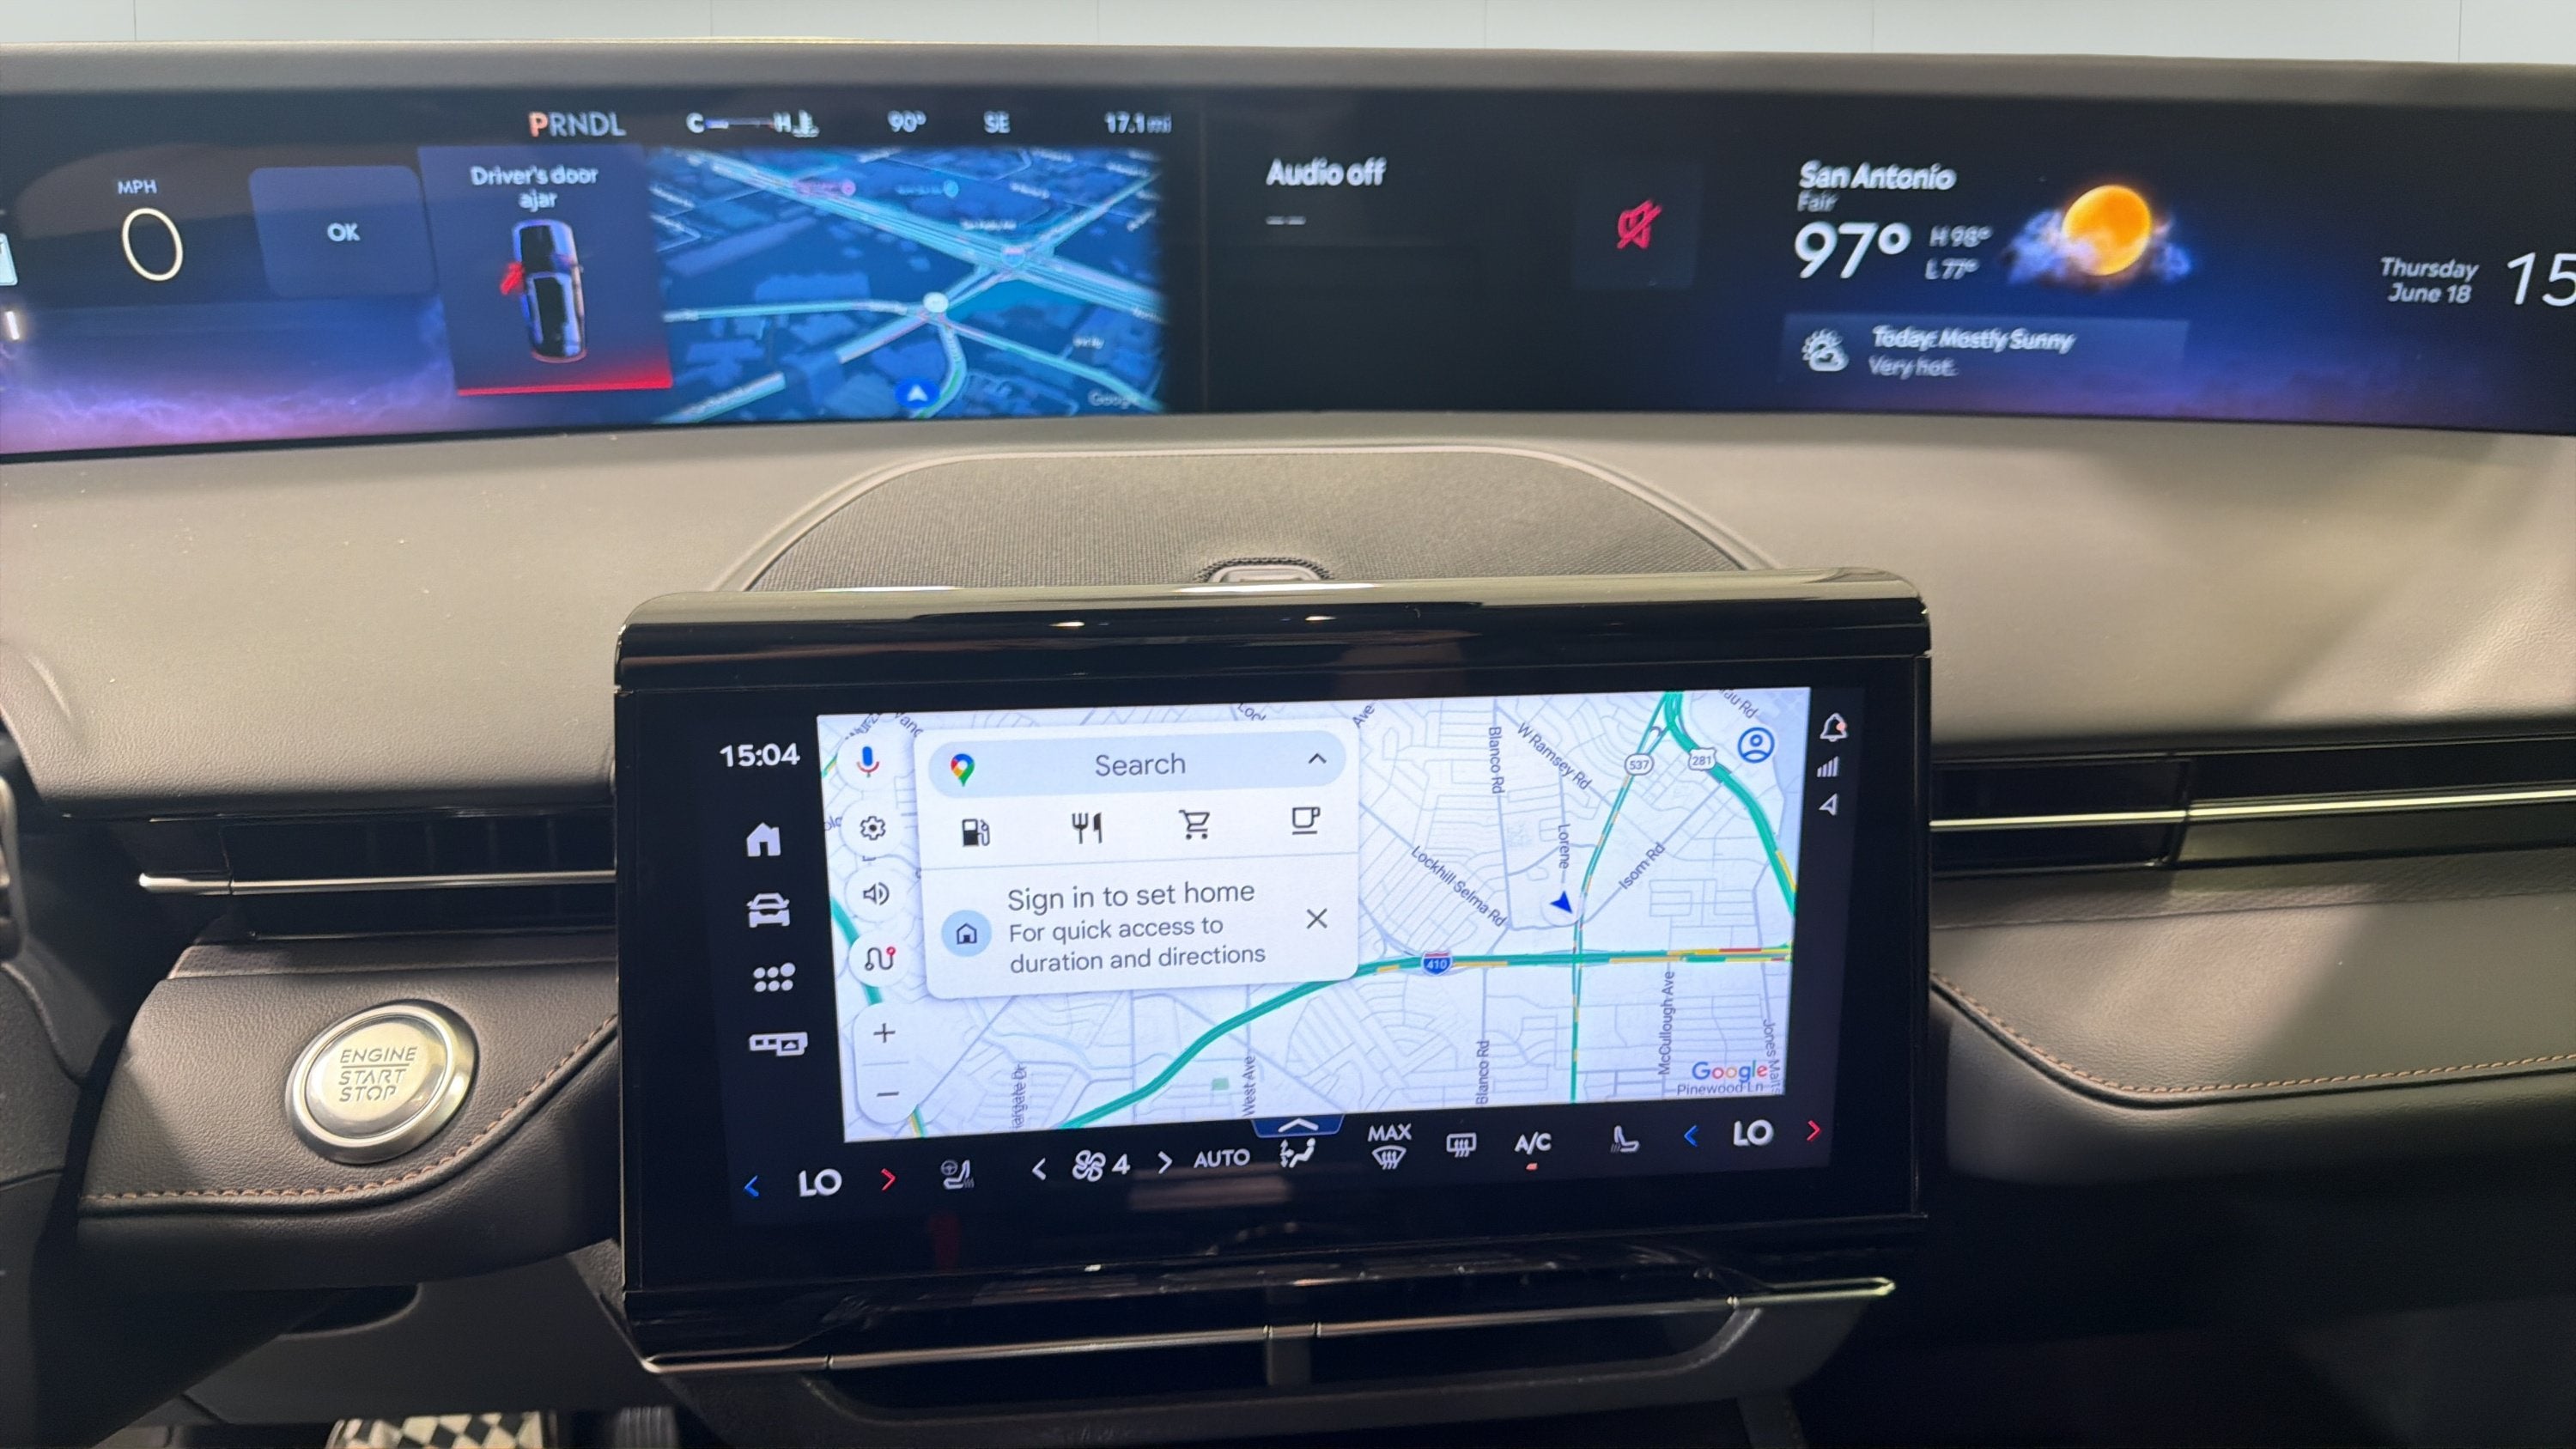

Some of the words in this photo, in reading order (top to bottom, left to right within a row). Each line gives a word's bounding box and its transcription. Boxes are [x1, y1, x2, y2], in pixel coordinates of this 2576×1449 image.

[530, 113, 626, 137] PRNDL
[687, 113, 704, 133] C
[774, 112, 791, 132] H
[888, 110, 926, 132] 90°
[984, 111, 1010, 133] SE
[1105, 112, 1145, 133] 17.1
[471, 166, 549, 186] Driver's
[553, 167, 598, 185] door
[1266, 157, 1345, 186] Audio
[1346, 157, 1387, 186] off
[1800, 160, 1849, 189] San
[1850, 161, 1957, 191] Antonio
[118, 180, 157, 195] MPH
[519, 191, 556, 212] ajar
[1797, 192, 1838, 212] Fair
[327, 223, 360, 242] OK
[1929, 228, 1948, 246] H
[1795, 222, 1911, 278] 97°
[1925, 259, 1938, 279] L
[2381, 257, 2479, 282] Thursday
[2506, 252, 2576, 307] 15
[2388, 283, 2442, 302] June
[2446, 285, 2472, 303] 18
[1939, 329, 2008, 353] Mostly
[2008, 329, 2076, 354] Sunny
[1868, 356, 1915, 380] Very
[1352, 704, 1375, 728] Ave
[1718, 689, 1741, 705] au
[1739, 700, 1759, 719] Rd
[720, 743, 800, 768] 15:04
[1489, 727, 1502, 774] Blanco
[1517, 721, 1534, 739] W
[1528, 734, 1575, 777] Ramsey
[1572, 770, 1593, 790] Rd
[1692, 756, 1711, 766] 281
[1096, 752, 1187, 777] Search
[1630, 760, 1649, 770] 537
[1492, 776, 1505, 795] Rd
[1558, 824, 1571, 869] Lorene
[1619, 858, 1651, 890] Isom
[1645, 842, 1666, 864] Rd
[1007, 888, 1066, 917] Sign
[1072, 886, 1096, 908] in
[1103, 886, 1128, 907] to
[1136, 884, 1176, 906] set
[1184, 881, 1256, 904] home
[1411, 846, 1455, 886] Lockhill
[1452, 880, 1489, 915] Selma
[1487, 908, 1509, 928] Rd
[1009, 923, 1045, 943] For
[1052, 920, 1113, 946] quick
[1118, 922, 1195, 939] access
[1201, 916, 1224, 935] to
[1010, 952, 1103, 974] duration
[1109, 947, 1151, 970] and
[1157, 945, 1267, 967] directions
[1426, 959, 1448, 970] 410
[1662, 971, 1674, 995] Ave
[1476, 1039, 1490, 1057] Rd
[1658, 1000, 1675, 1075] McCullough
[1763, 1019, 1776, 1057] Jones
[340, 1046, 418, 1063] ENGINE
[338, 1068, 406, 1086] START
[1242, 1056, 1256, 1081] Ave
[1692, 1060, 1768, 1083] Google
[338, 1086, 397, 1102] STOP
[1475, 1059, 1488, 1105] Blanco
[1677, 1084, 1743, 1095] Pinewood
[1747, 1083, 1764, 1093] Ln
[1242, 1083, 1256, 1117] West
[1368, 1123, 1412, 1142] MAX
[1515, 1132, 1552, 1153] A/C
[1733, 1120, 1773, 1147] LO
[1112, 1154, 1131, 1175] 4
[1194, 1149, 1250, 1168] AUTO
[799, 1169, 842, 1196] LO
